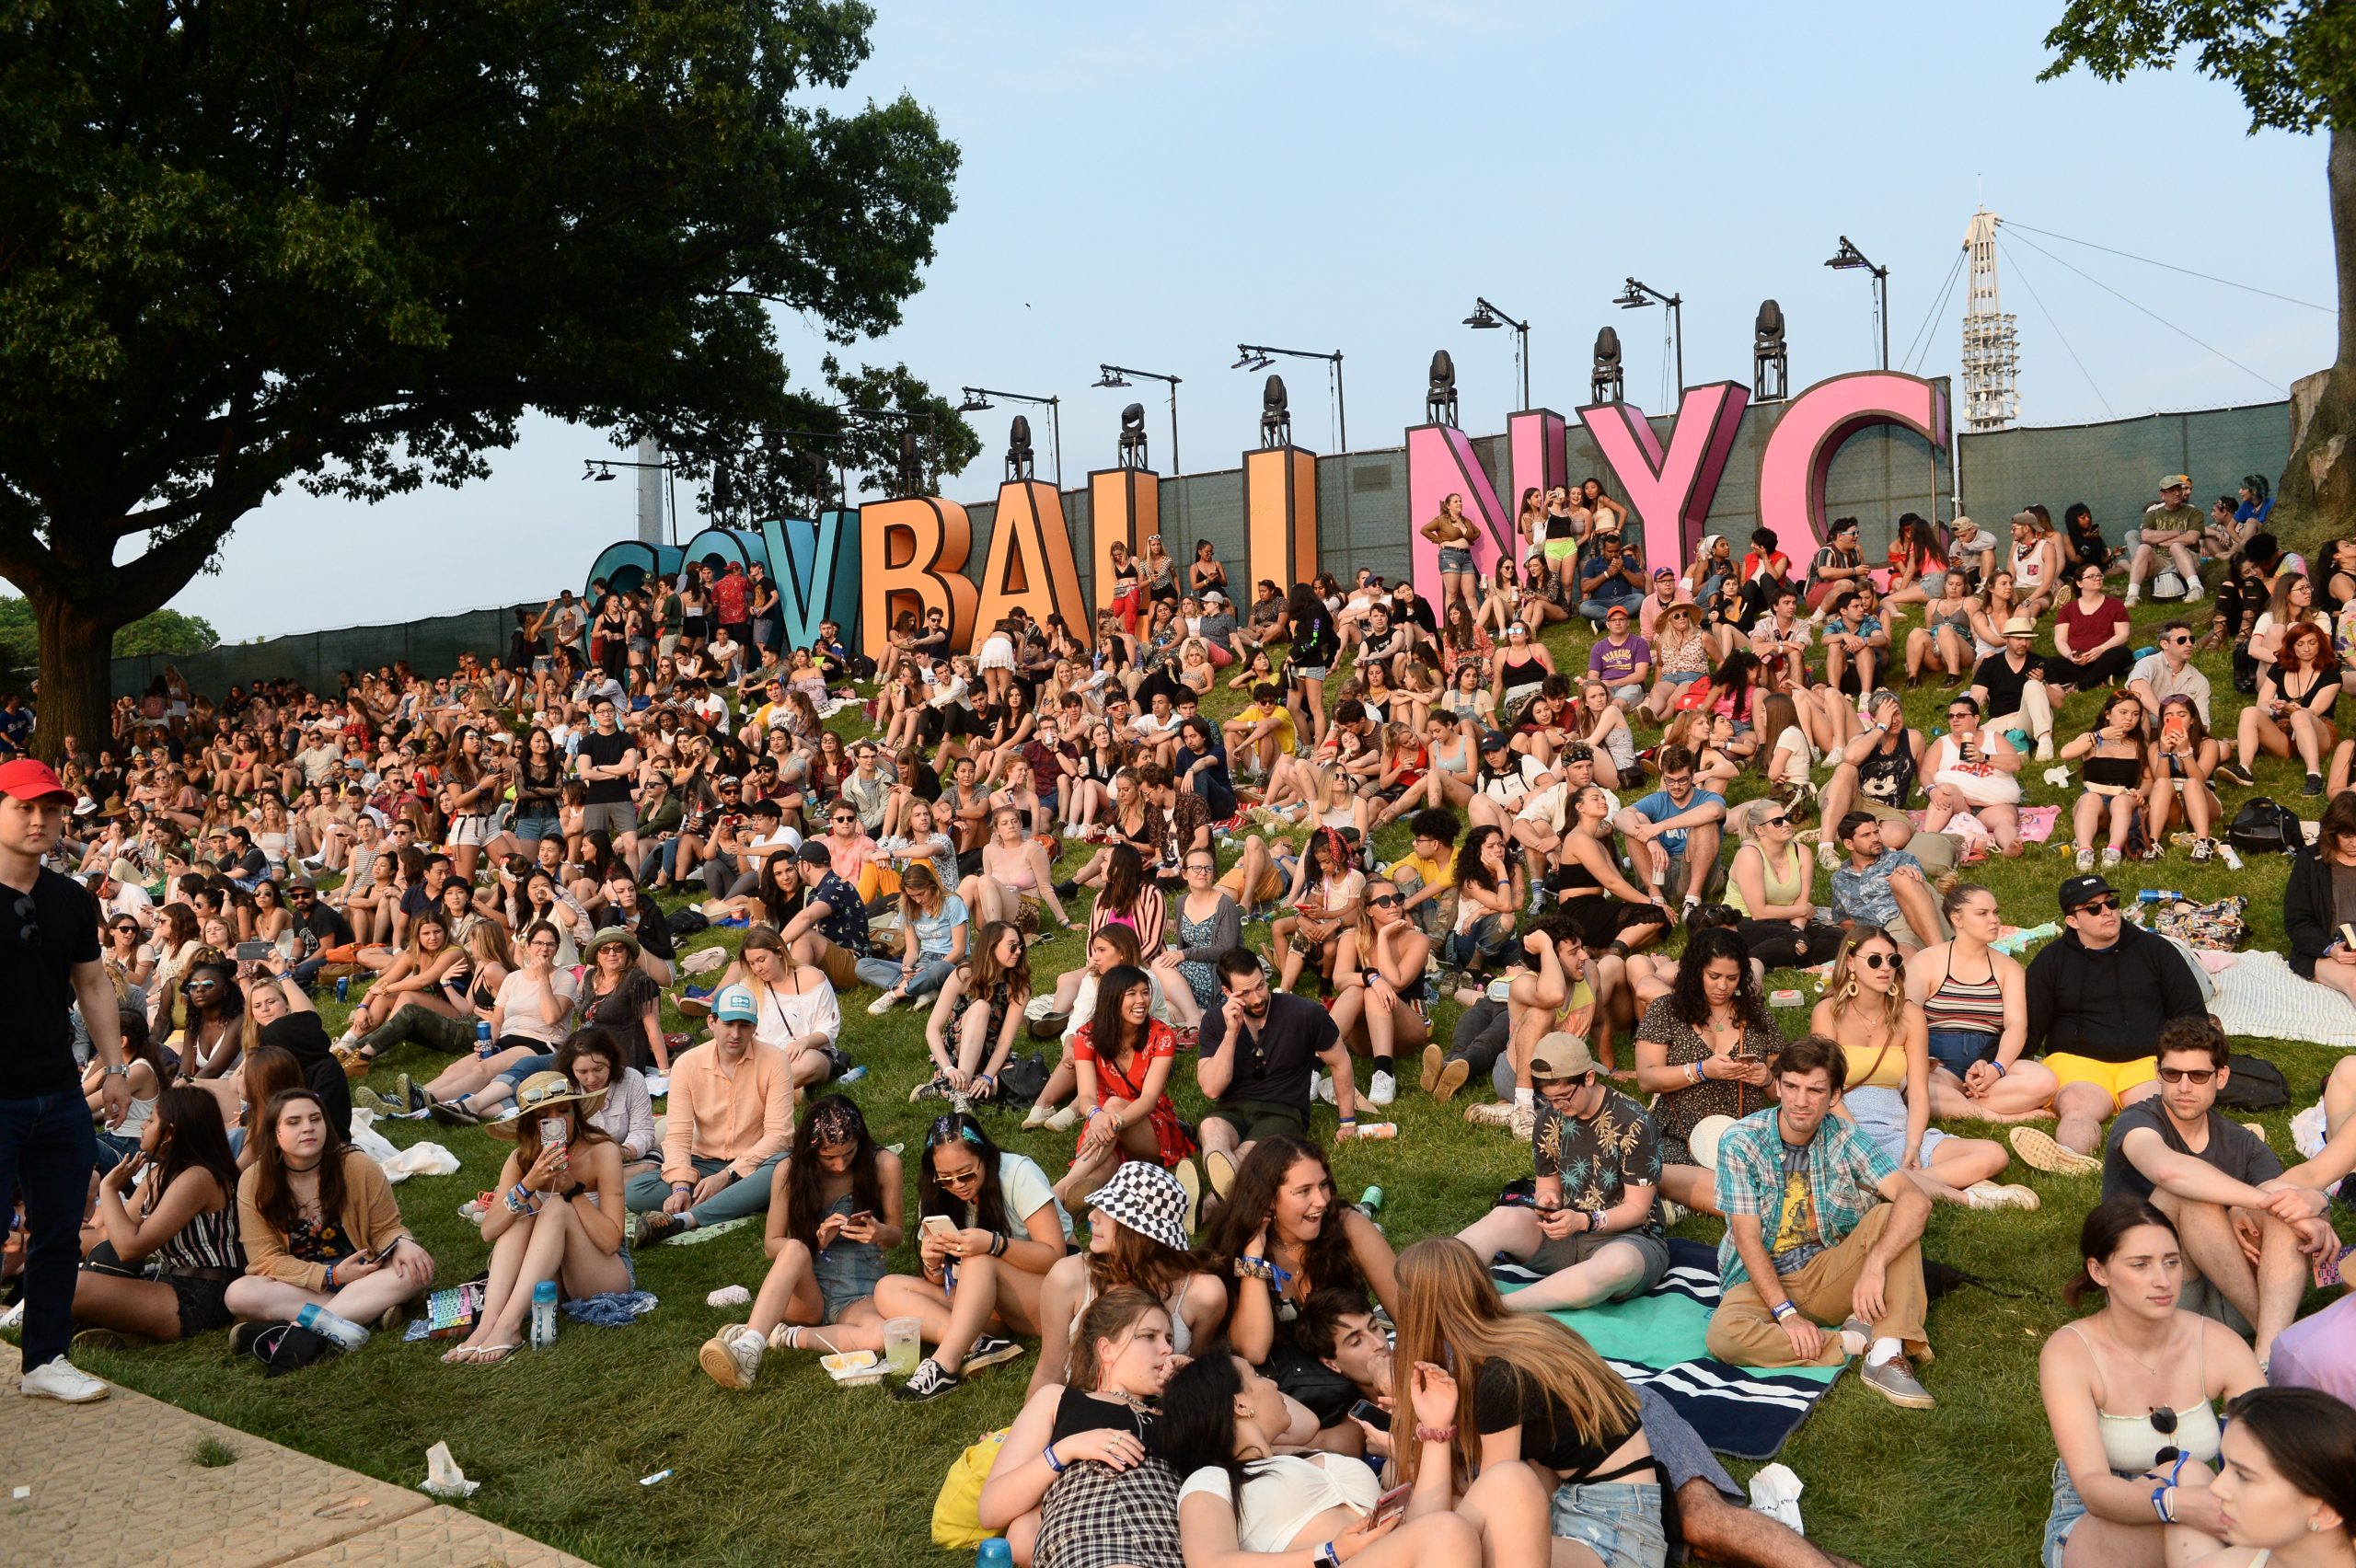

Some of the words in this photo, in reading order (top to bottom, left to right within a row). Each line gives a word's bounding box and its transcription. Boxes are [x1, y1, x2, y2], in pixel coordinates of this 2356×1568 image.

[1405, 370, 1949, 628] NYC
[1666, 827, 1689, 840] VAN
[314, 1327, 348, 1347] core
